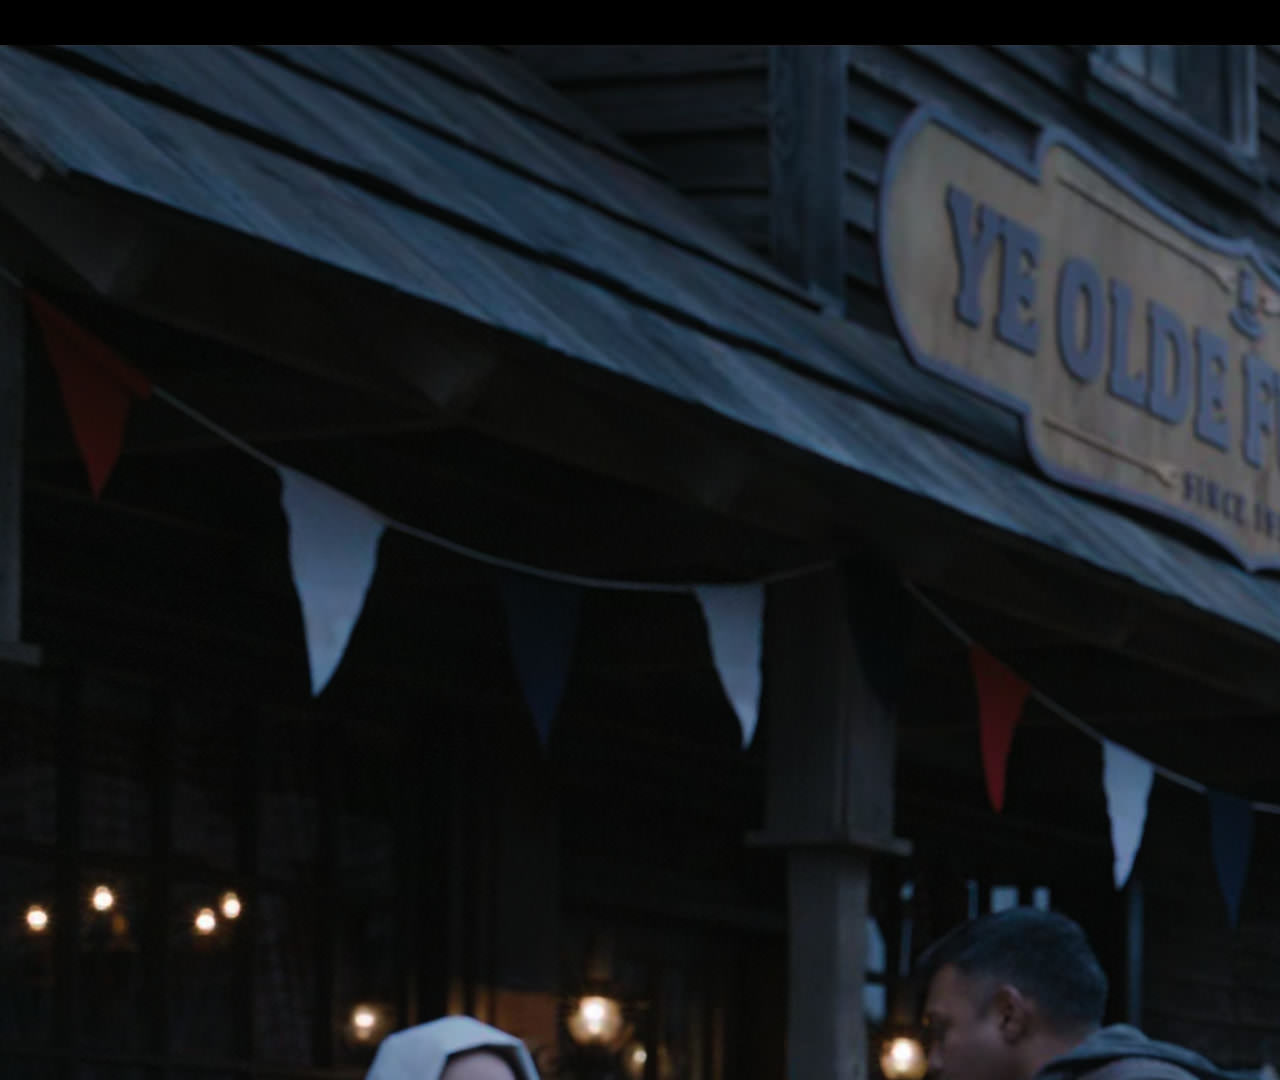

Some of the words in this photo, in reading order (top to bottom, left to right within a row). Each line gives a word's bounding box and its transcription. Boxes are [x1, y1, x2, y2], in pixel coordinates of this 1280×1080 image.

[945, 184, 1042, 356] YE
[1056, 256, 1230, 454] OLDE
[1182, 471, 1247, 527] SINCE
